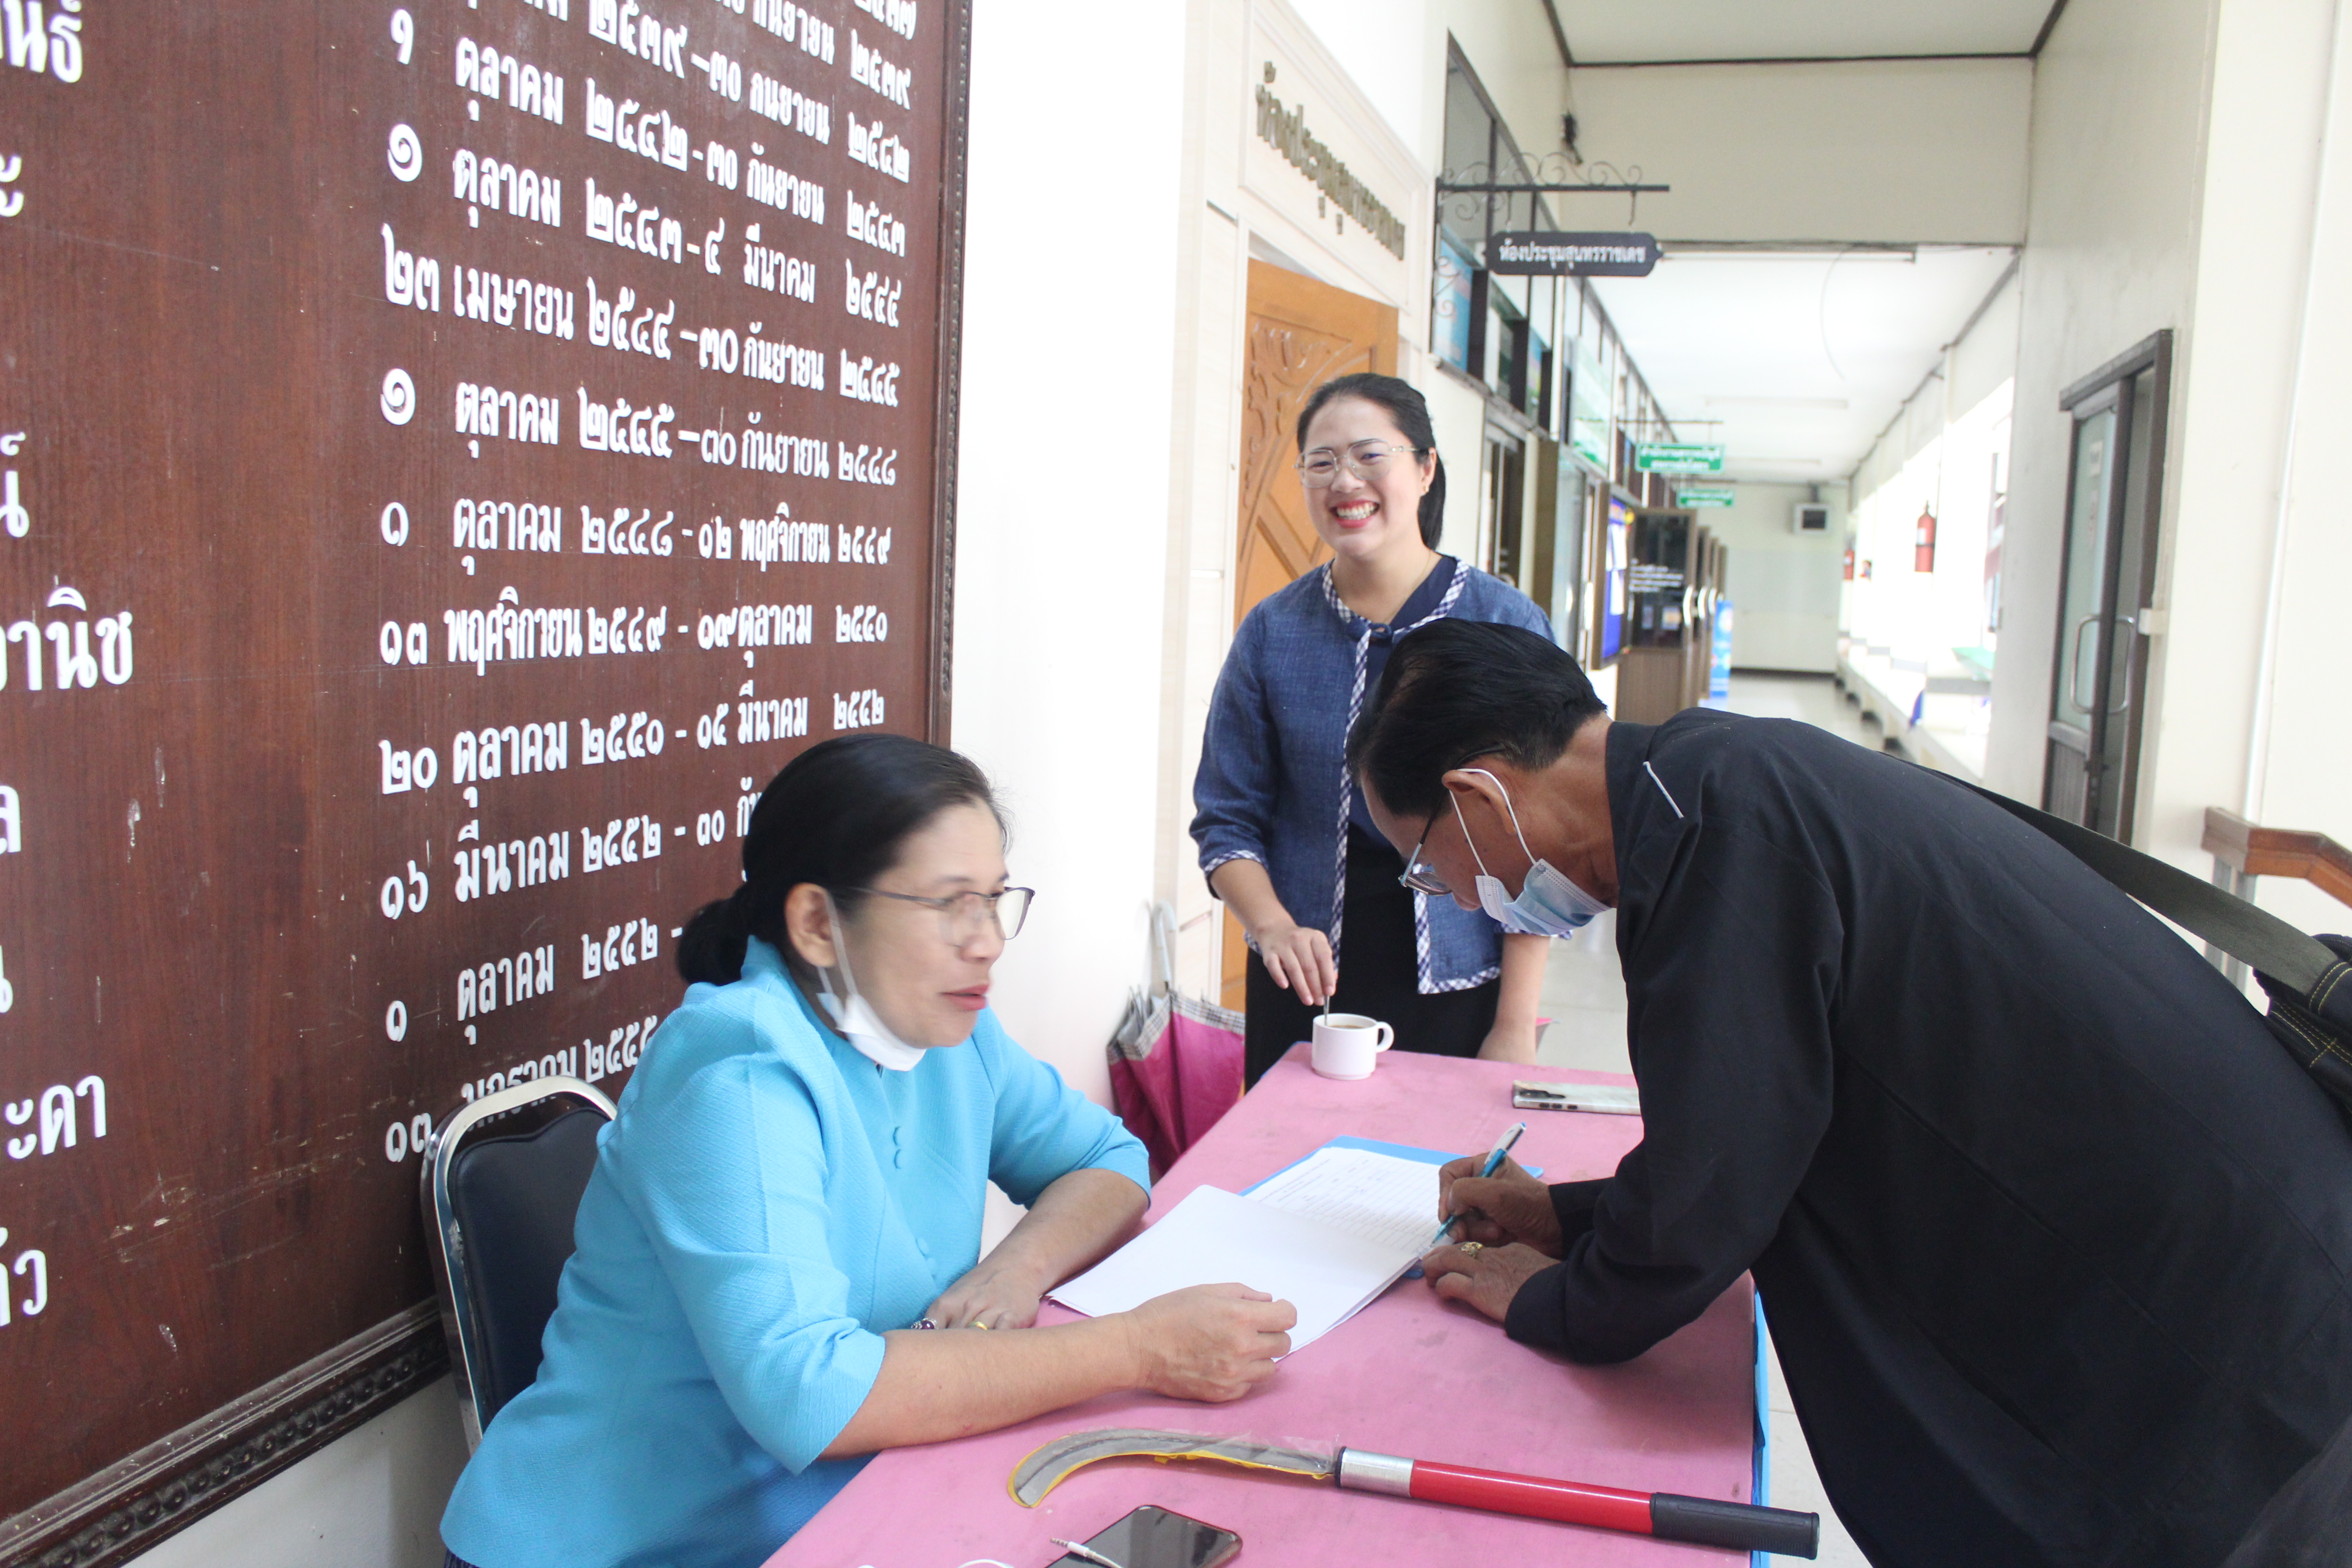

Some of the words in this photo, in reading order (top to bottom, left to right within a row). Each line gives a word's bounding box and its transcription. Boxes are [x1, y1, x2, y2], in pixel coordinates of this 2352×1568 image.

[455, 36, 564, 125] ตุลาคม
[585, 77, 688, 172] ๒๕๔๒
[706, 140, 738, 191] ๓๐
[746, 141, 825, 225] กันยายน
[846, 189, 906, 258] ๒๕๔๓
[709, 50, 742, 102] ๓๐
[847, 111, 911, 184] ๒๕๔๒
[387, 123, 423, 182] ๑
[452, 148, 561, 229] ตุลาคม
[585, 176, 682, 264] ๒๕๔๓
[743, 222, 816, 304] มีนาคม
[381, 222, 440, 312] ๒๓
[453, 265, 574, 341] เมษายน
[698, 327, 739, 374] ๓๐
[743, 321, 825, 392] กันยายน
[839, 348, 901, 408] ๒๕๔๕
[380, 368, 416, 426] ๑
[455, 382, 559, 459] ตุลาคม
[576, 386, 676, 459] ๒๕๔๕
[701, 428, 737, 466] ๓๐
[741, 411, 830, 480] กันยายน
[380, 501, 409, 547] ๑
[453, 498, 562, 576] ตุลาคม
[698, 515, 732, 560] ๑๒
[739, 501, 831, 573] พฤศจิกายน
[837, 523, 892, 565] ๒๕๔๙
[0, 586, 133, 691] านิช
[379, 620, 427, 666] ๑๓
[443, 585, 583, 677] พฤศจิกายน
[586, 605, 667, 655] ๒๕๔๙
[835, 604, 888, 643] ๒๕๕๐
[378, 739, 438, 795] ๒๐
[452, 720, 568, 808] ตุลาคม
[579, 710, 664, 765] ๒๕๕๐
[696, 702, 729, 750] ๑๕
[737, 679, 808, 745] มีนาคม
[833, 688, 885, 730] ๒๕๕๒
[380, 859, 429, 920] ๑๖
[453, 819, 569, 903] มีนาคม
[580, 814, 661, 873] ๒๕๕๒
[696, 809, 725, 847] ๓๐
[385, 1000, 407, 1042] ๑
[457, 944, 554, 1045] ตุลาคม
[581, 917, 658, 980] ๒๕๕๒
